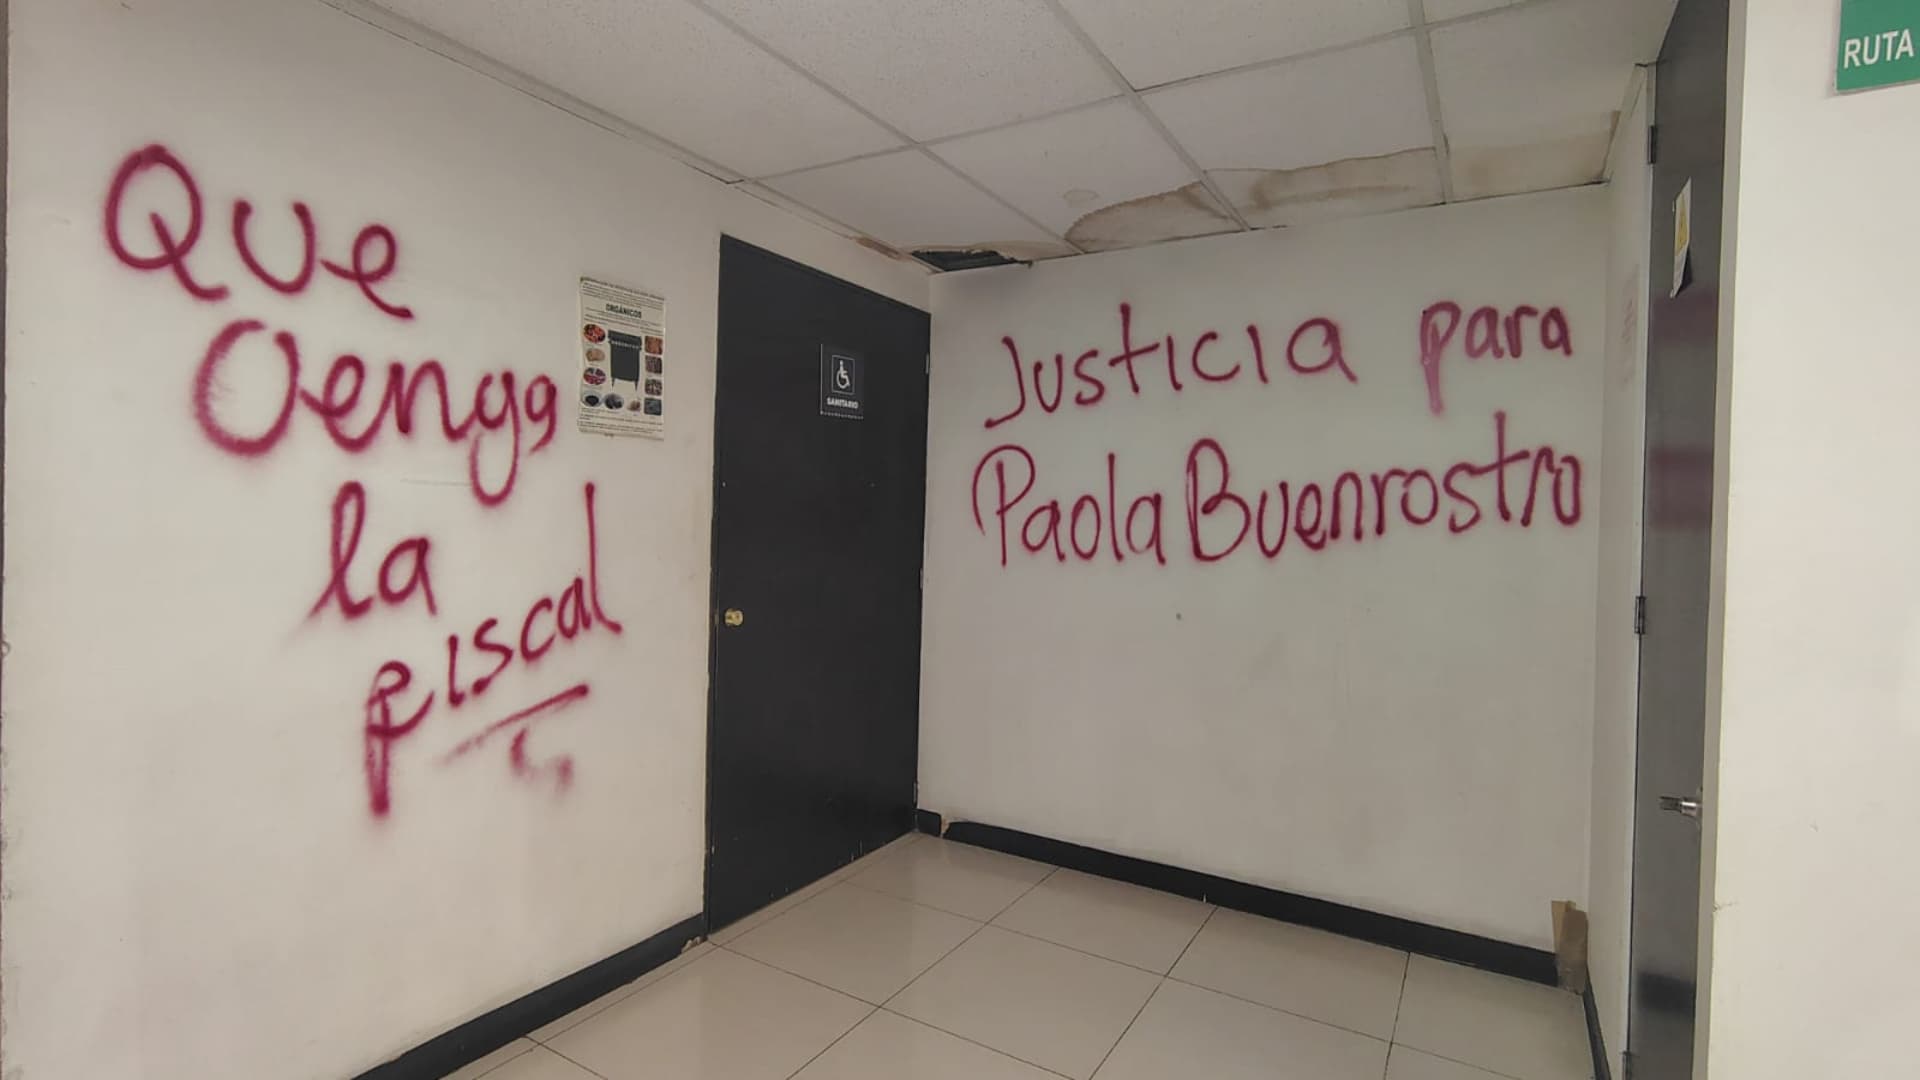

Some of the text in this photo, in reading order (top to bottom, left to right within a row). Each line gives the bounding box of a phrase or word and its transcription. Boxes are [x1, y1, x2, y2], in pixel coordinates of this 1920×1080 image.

[1844, 28, 1914, 69] RUTA
[606, 303, 642, 319] ORGÁNICOS
[827, 397, 859, 409] SANITARIO
[984, 300, 1573, 429] Justicia para
[972, 411, 1581, 567] Paola Buenrostro
[306, 480, 437, 620] la
